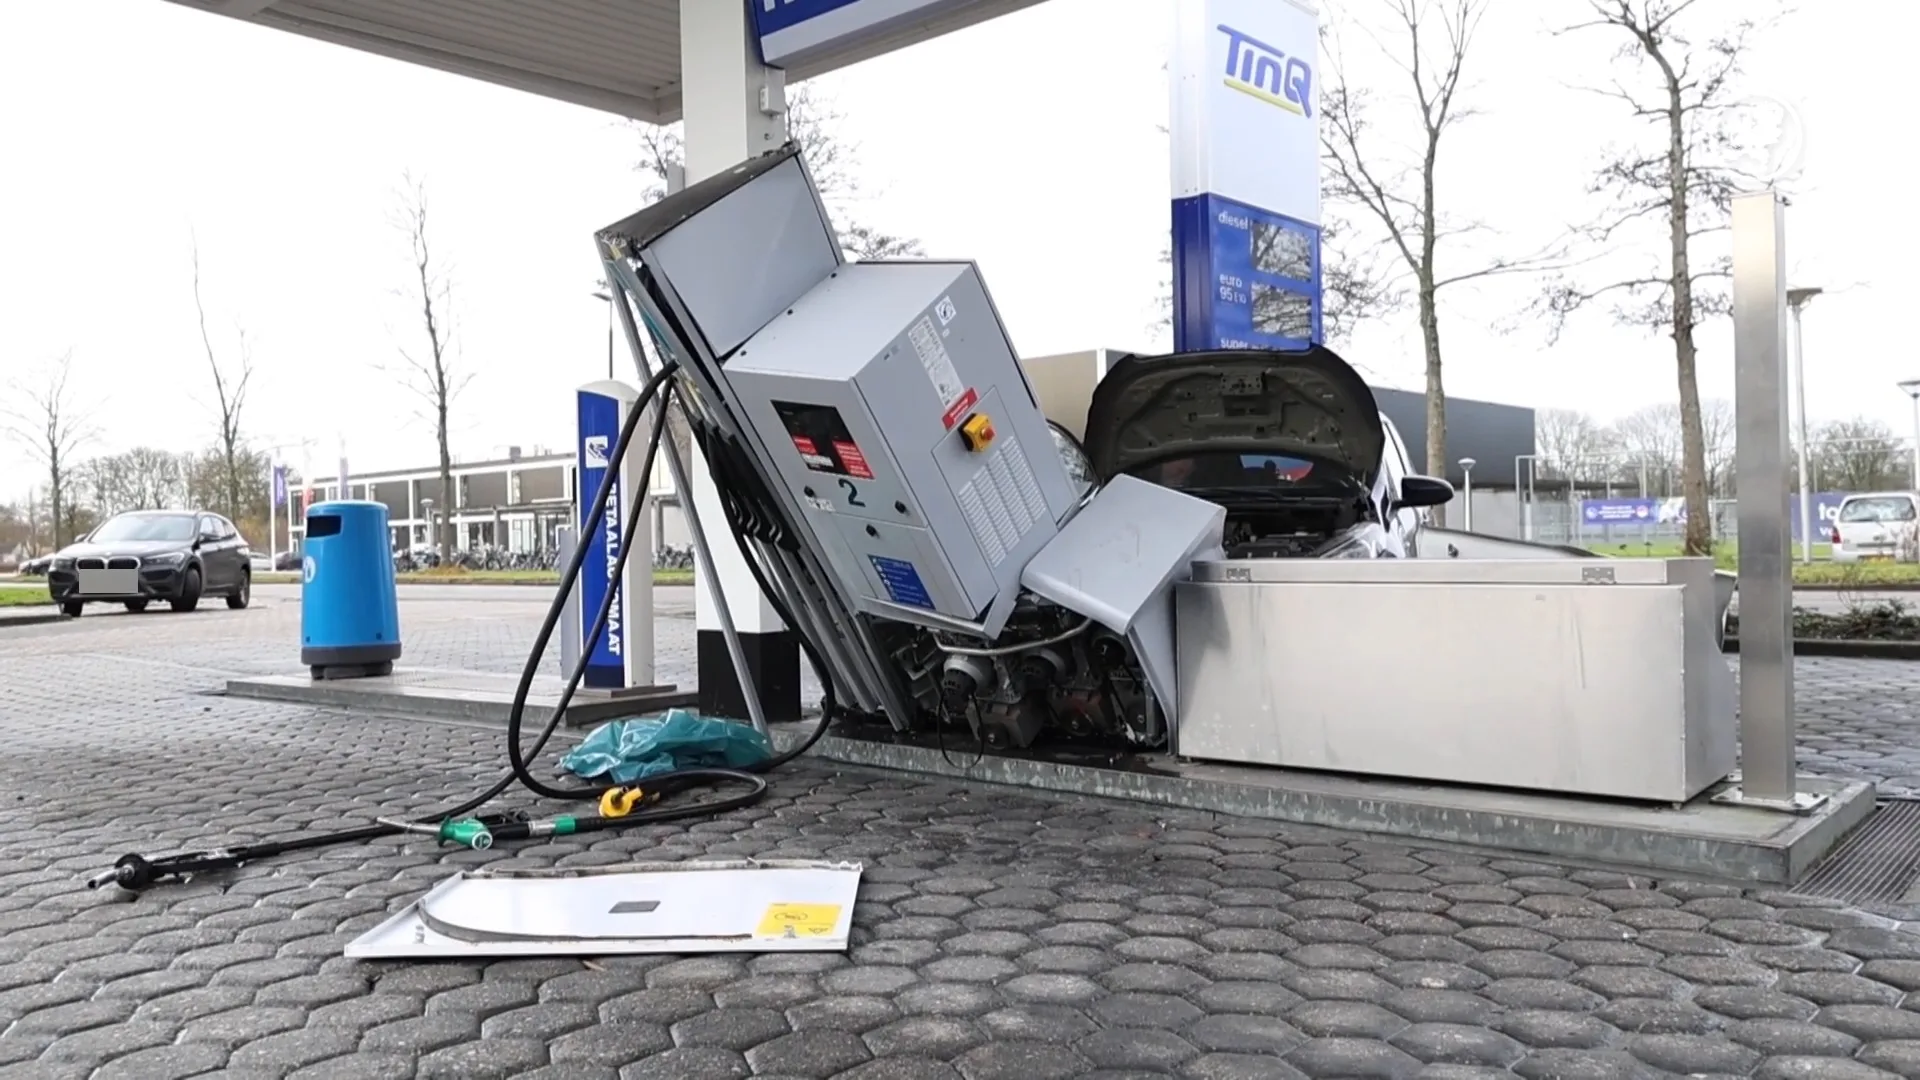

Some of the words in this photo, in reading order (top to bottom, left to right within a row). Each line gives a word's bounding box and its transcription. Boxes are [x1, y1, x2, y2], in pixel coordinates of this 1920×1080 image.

[1218, 210, 1248, 230] diesel
[1219, 274, 1242, 288] euro
[1219, 286, 1233, 301] 95
[838, 478, 866, 507] 2
